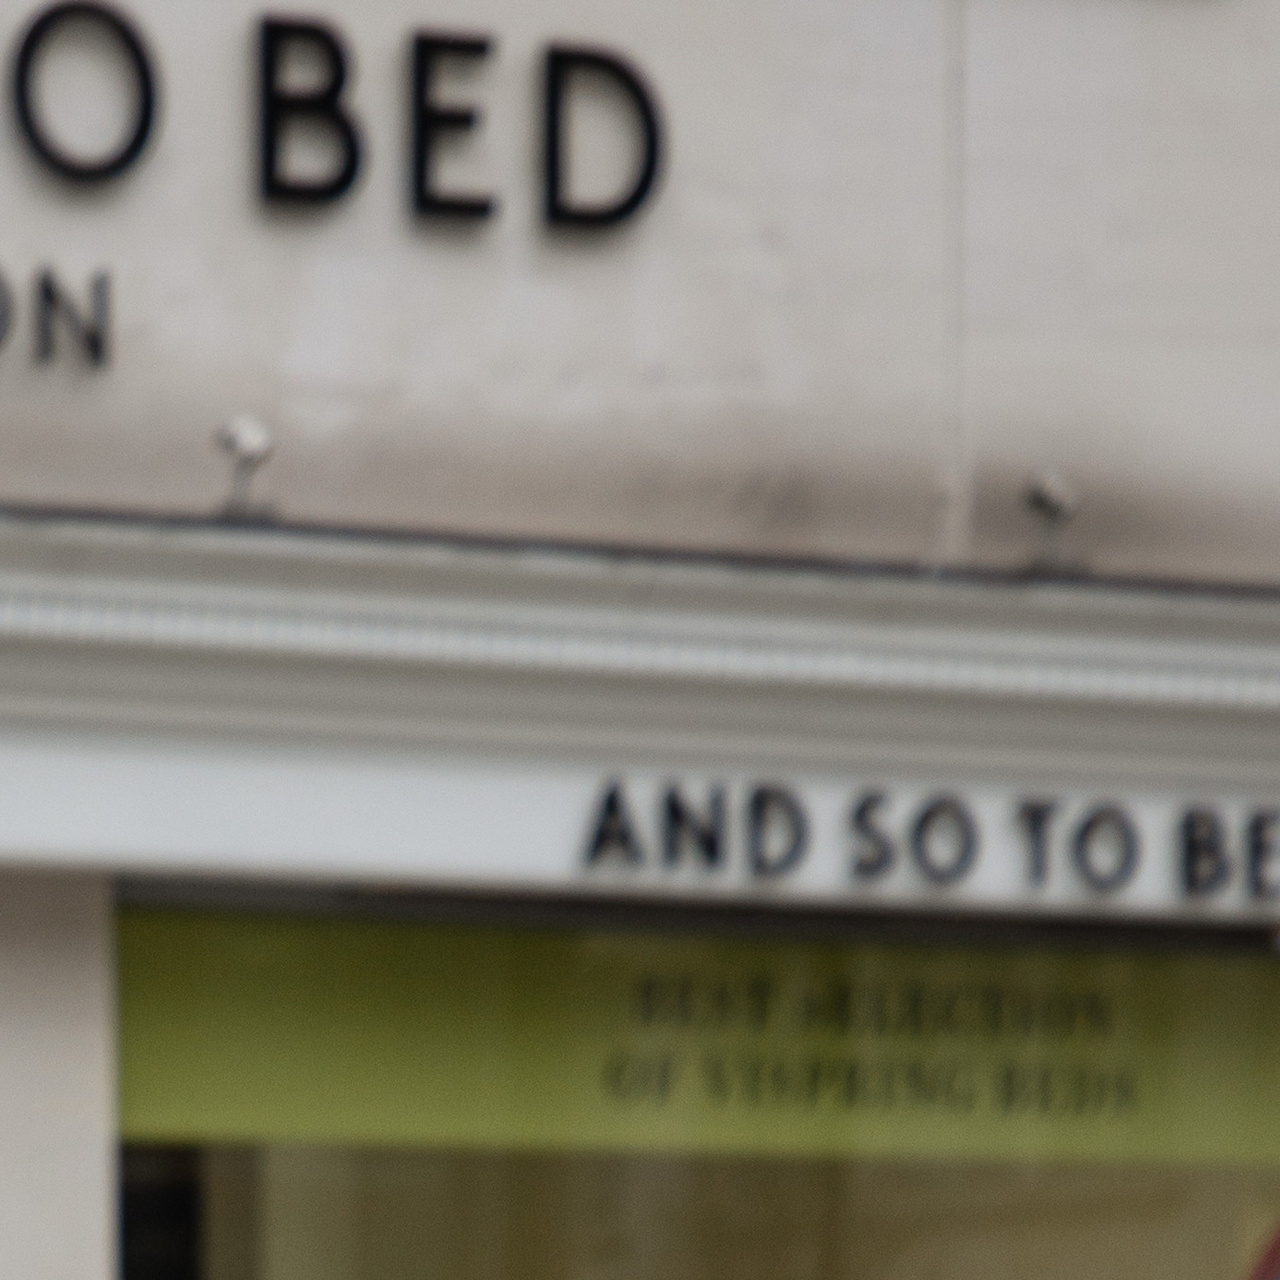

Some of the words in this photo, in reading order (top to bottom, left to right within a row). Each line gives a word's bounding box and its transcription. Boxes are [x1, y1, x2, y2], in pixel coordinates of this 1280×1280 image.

[255, 15, 662, 233] BED
[585, 778, 809, 877] AND
[850, 790, 978, 890] SO
[1017, 797, 1140, 893] TO
